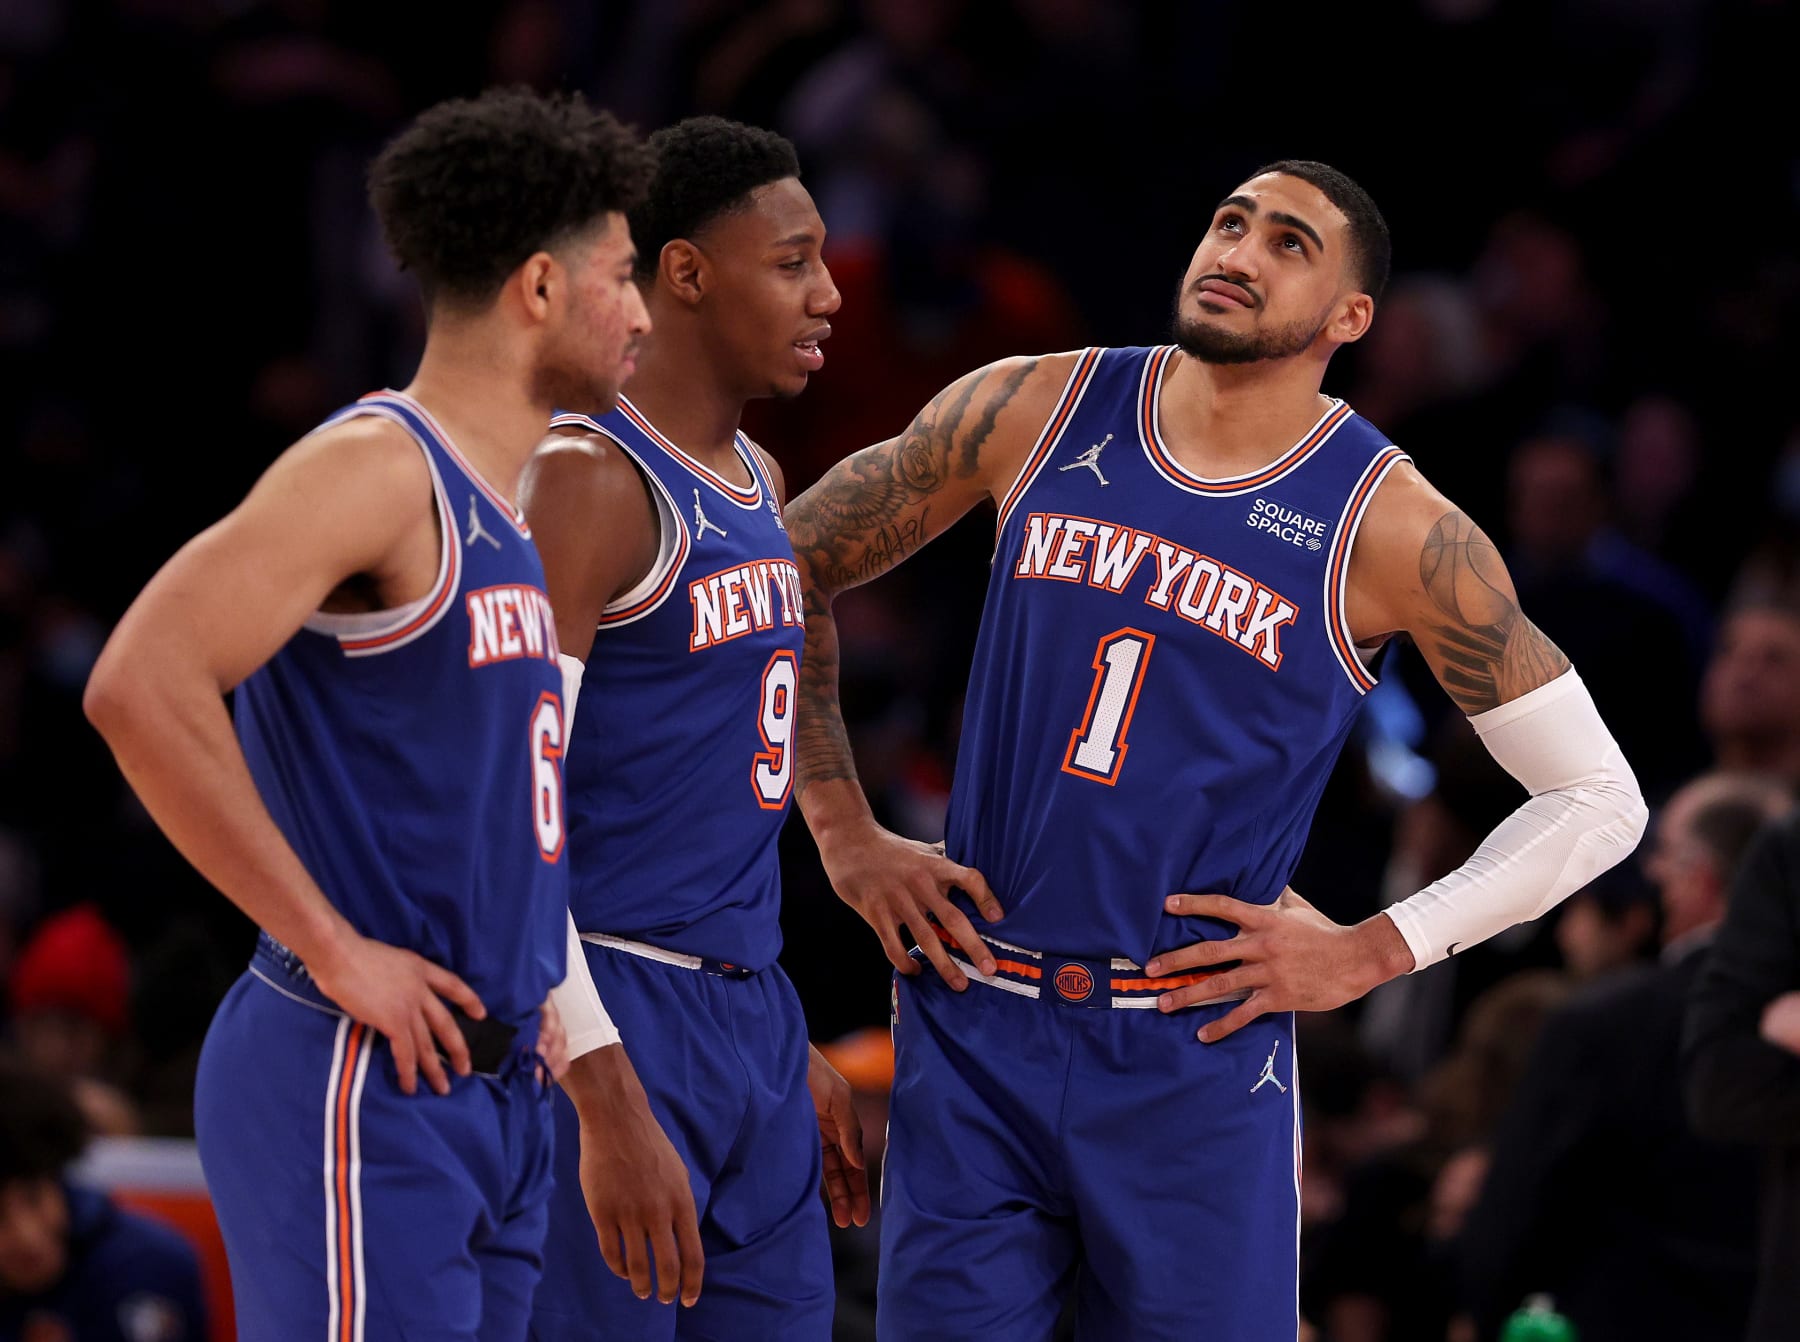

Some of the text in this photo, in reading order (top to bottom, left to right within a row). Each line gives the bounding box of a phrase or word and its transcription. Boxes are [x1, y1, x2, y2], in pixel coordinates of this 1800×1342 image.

[1246, 512, 1306, 547] SPACE
[1252, 498, 1327, 537] SQUARE
[465, 584, 545, 668] NEW
[689, 559, 774, 653] NEW
[1014, 513, 1157, 595] NEW
[1145, 543, 1300, 672] YORK
[750, 649, 799, 810] 9
[1061, 626, 1157, 786] 1
[529, 690, 566, 863] 6
[1058, 974, 1089, 992] KNICKS
